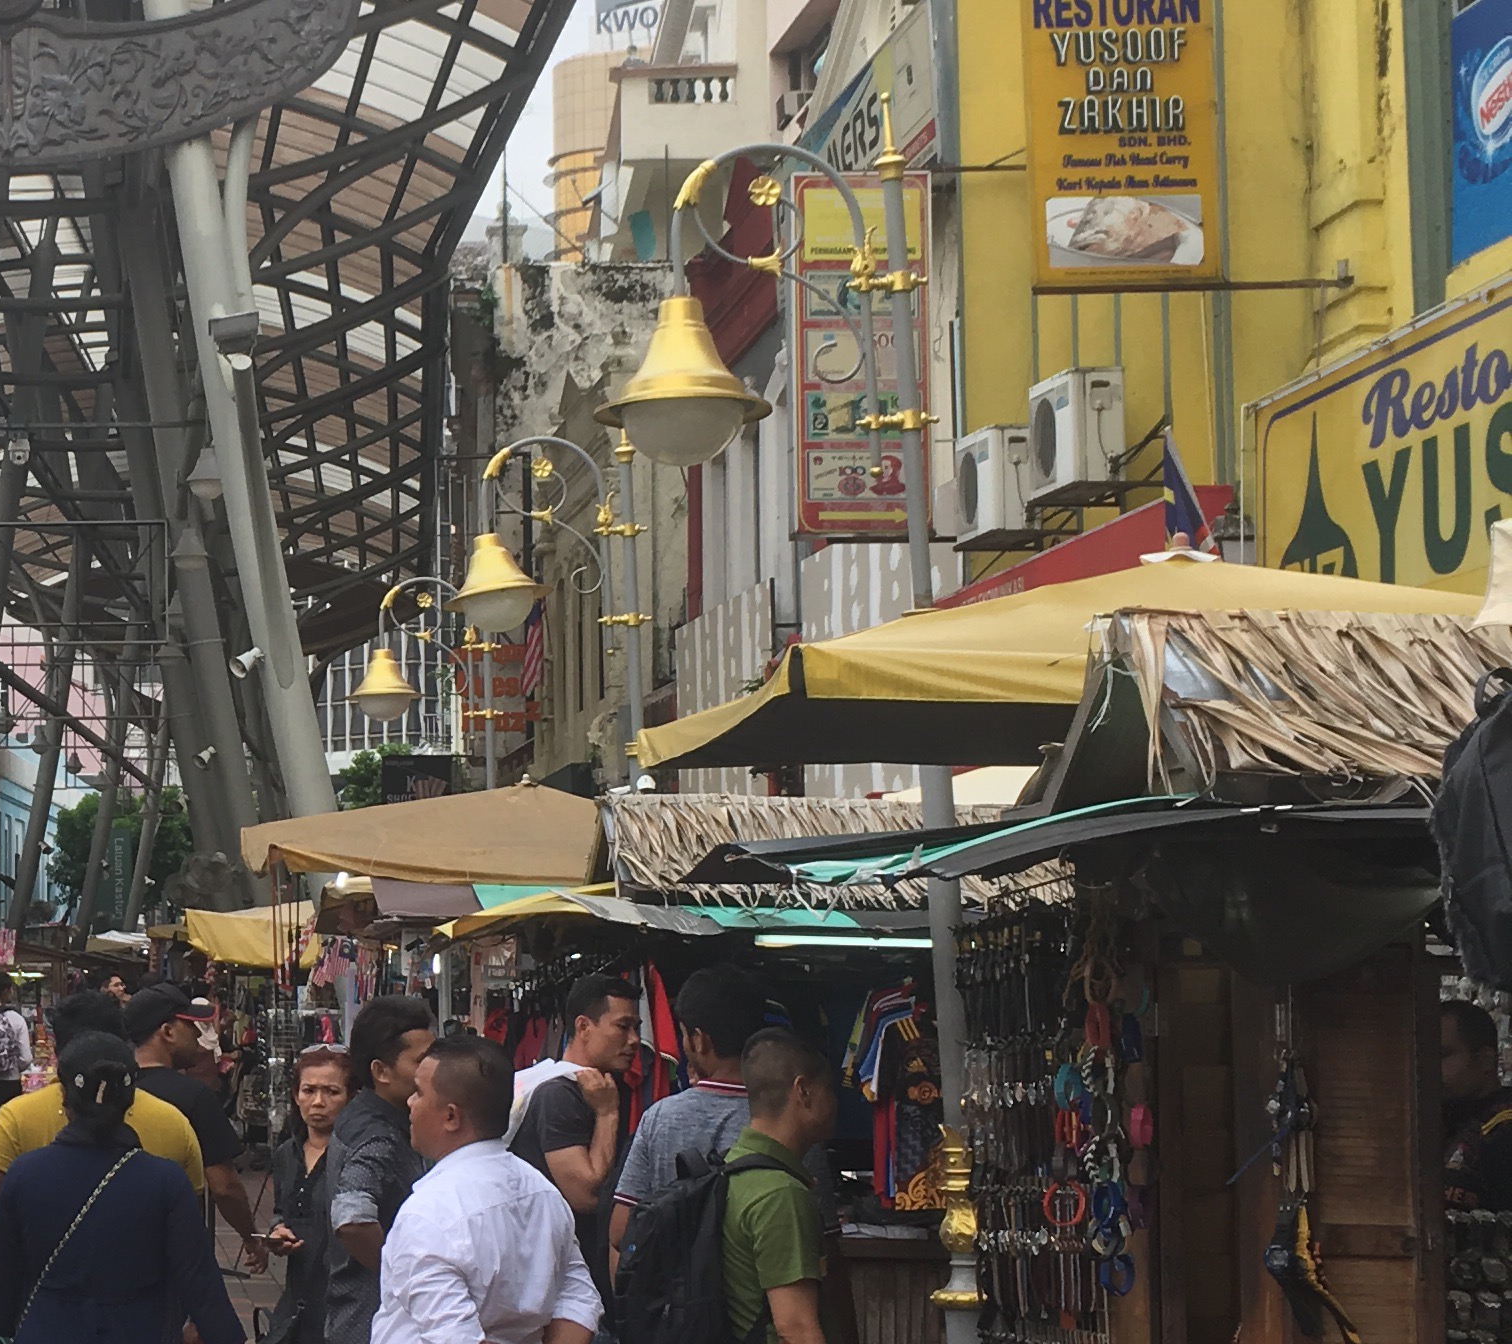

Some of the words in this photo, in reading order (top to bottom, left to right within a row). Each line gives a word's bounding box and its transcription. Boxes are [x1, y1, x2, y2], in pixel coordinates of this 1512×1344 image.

[596, 6, 660, 35] KWO
[1050, 27, 1188, 67] YUSOOF
[1085, 66, 1155, 93] DAN
[1057, 94, 1186, 135] ZAKHIR
[1118, 136, 1152, 148] SDN.
[1156, 135, 1192, 147] BHD.
[1159, 150, 1190, 169] Curry
[1362, 342, 1512, 449] Resto
[114, 837, 125, 875] Laluan
